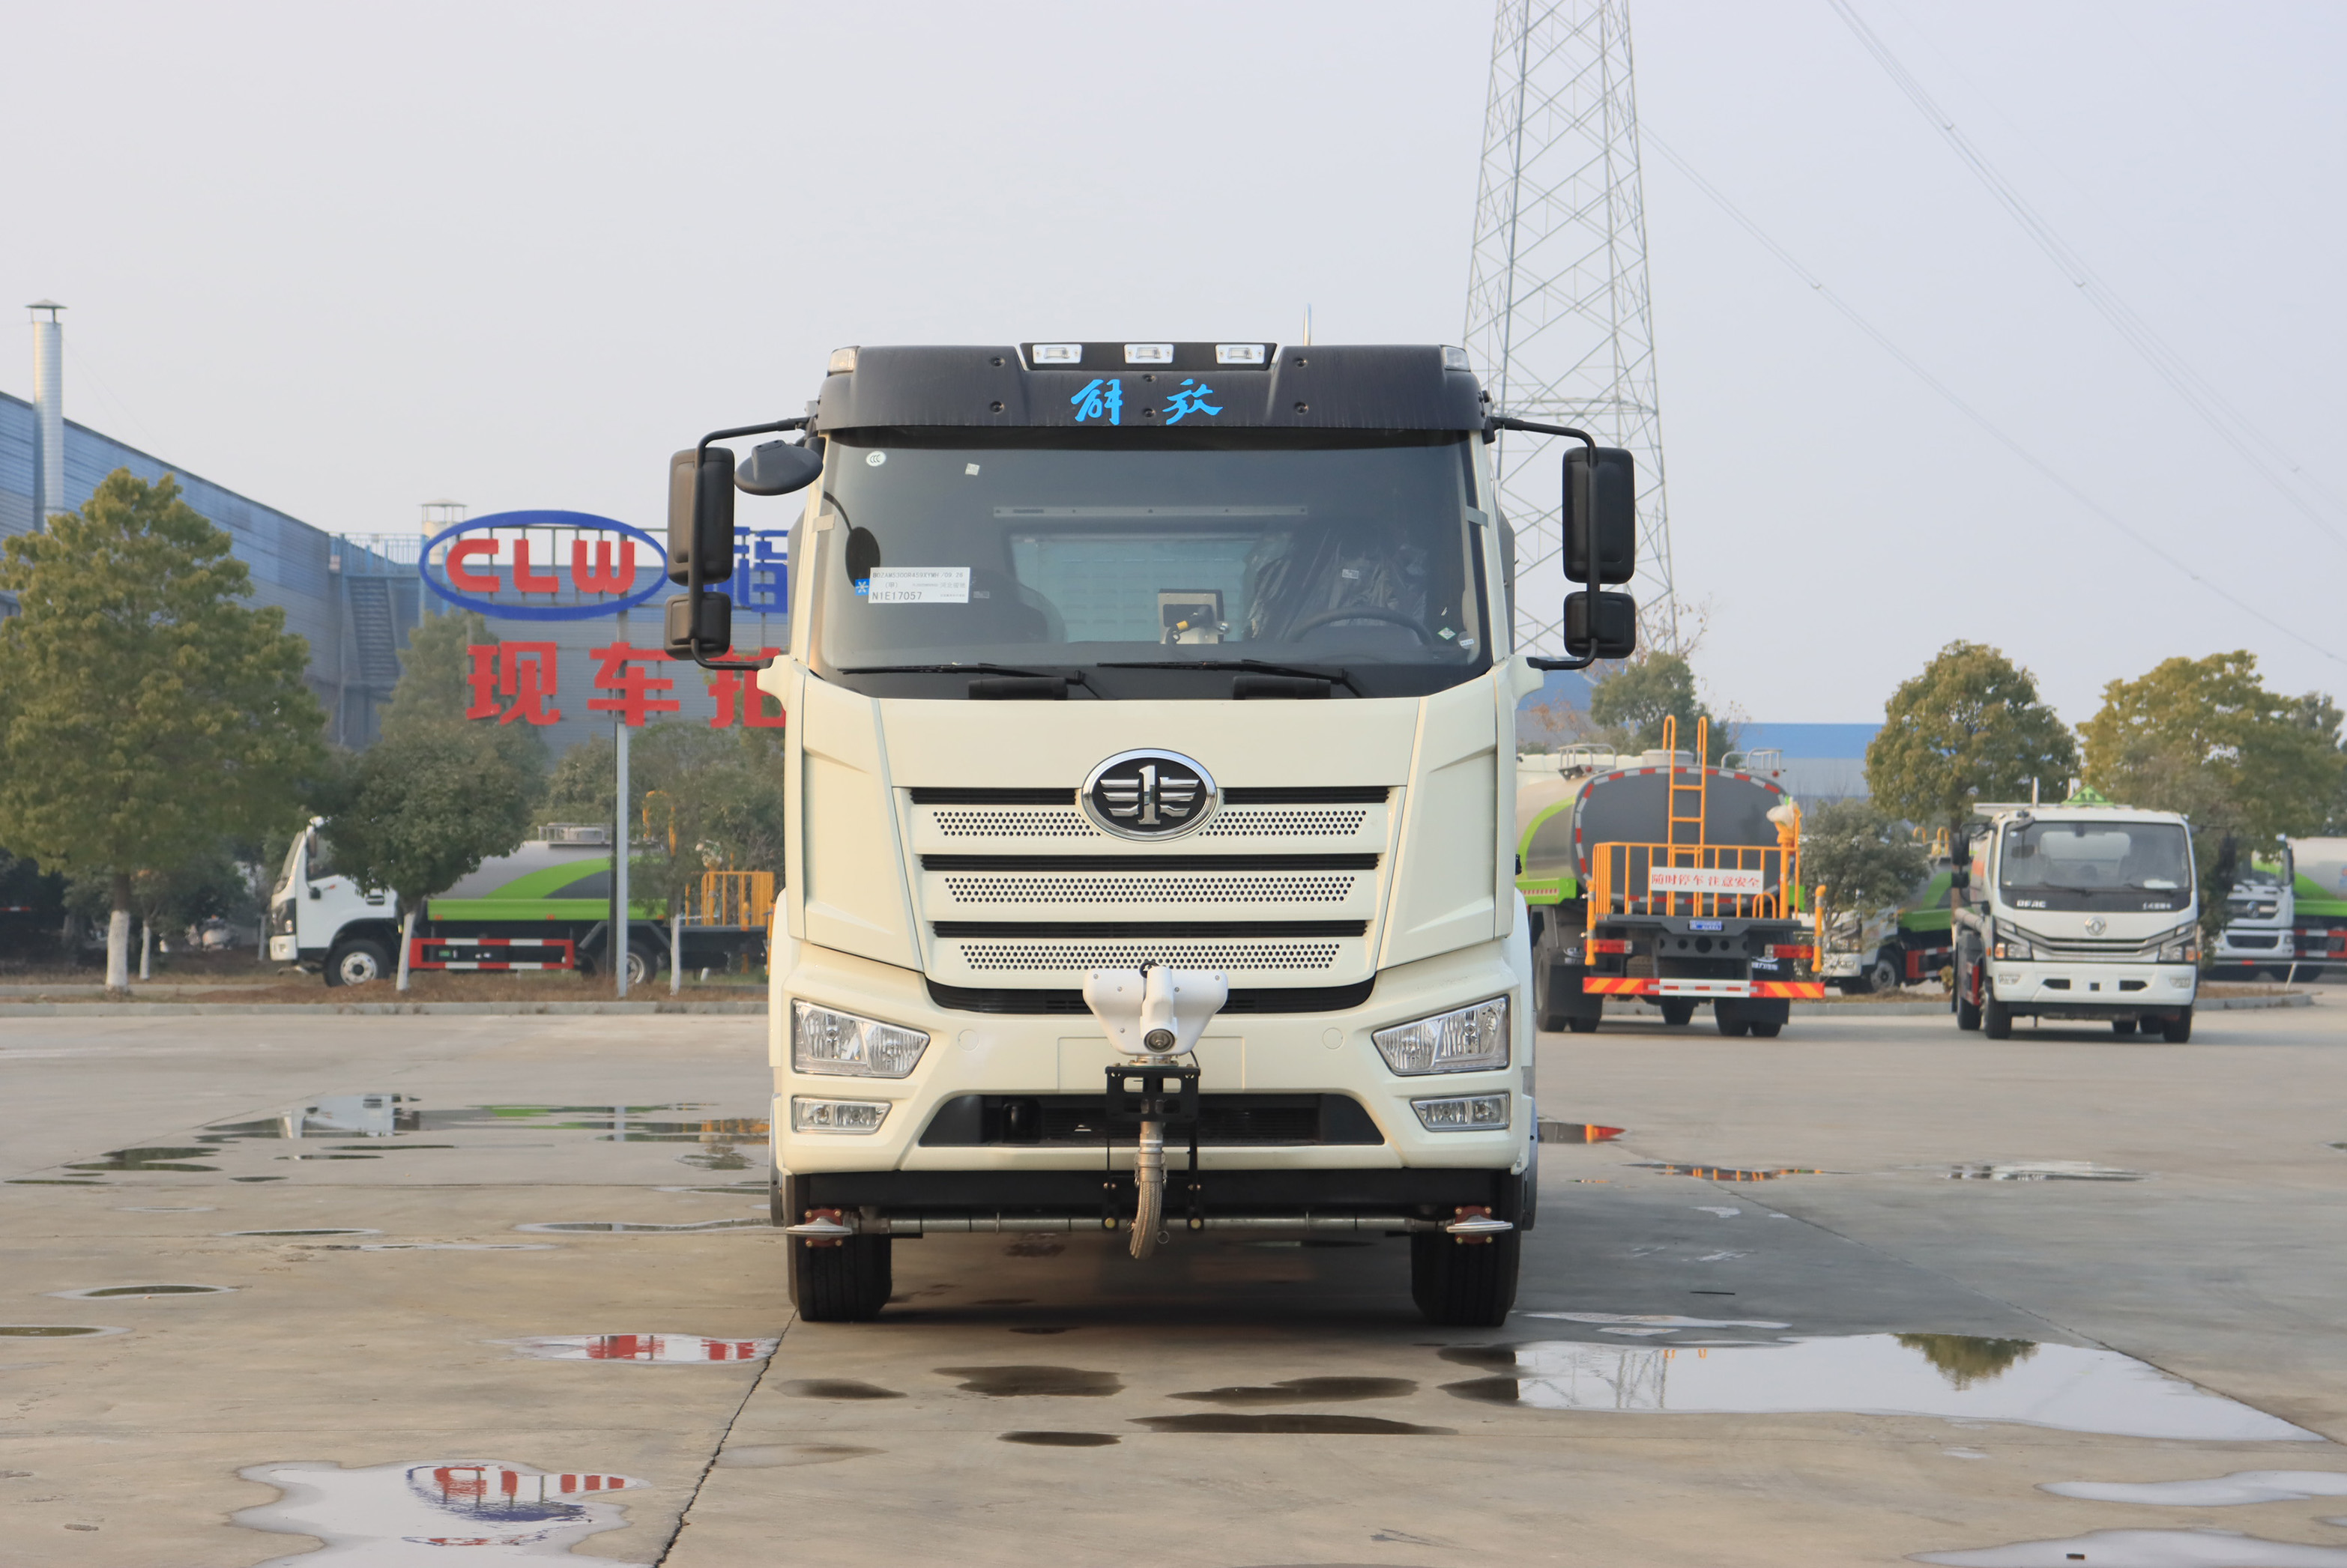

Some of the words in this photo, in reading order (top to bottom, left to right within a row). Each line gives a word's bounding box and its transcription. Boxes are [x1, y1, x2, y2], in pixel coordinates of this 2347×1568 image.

[1070, 378, 1224, 426] 解放
[445, 538, 635, 595] CLW
[872, 591, 922, 600] N1E17057
